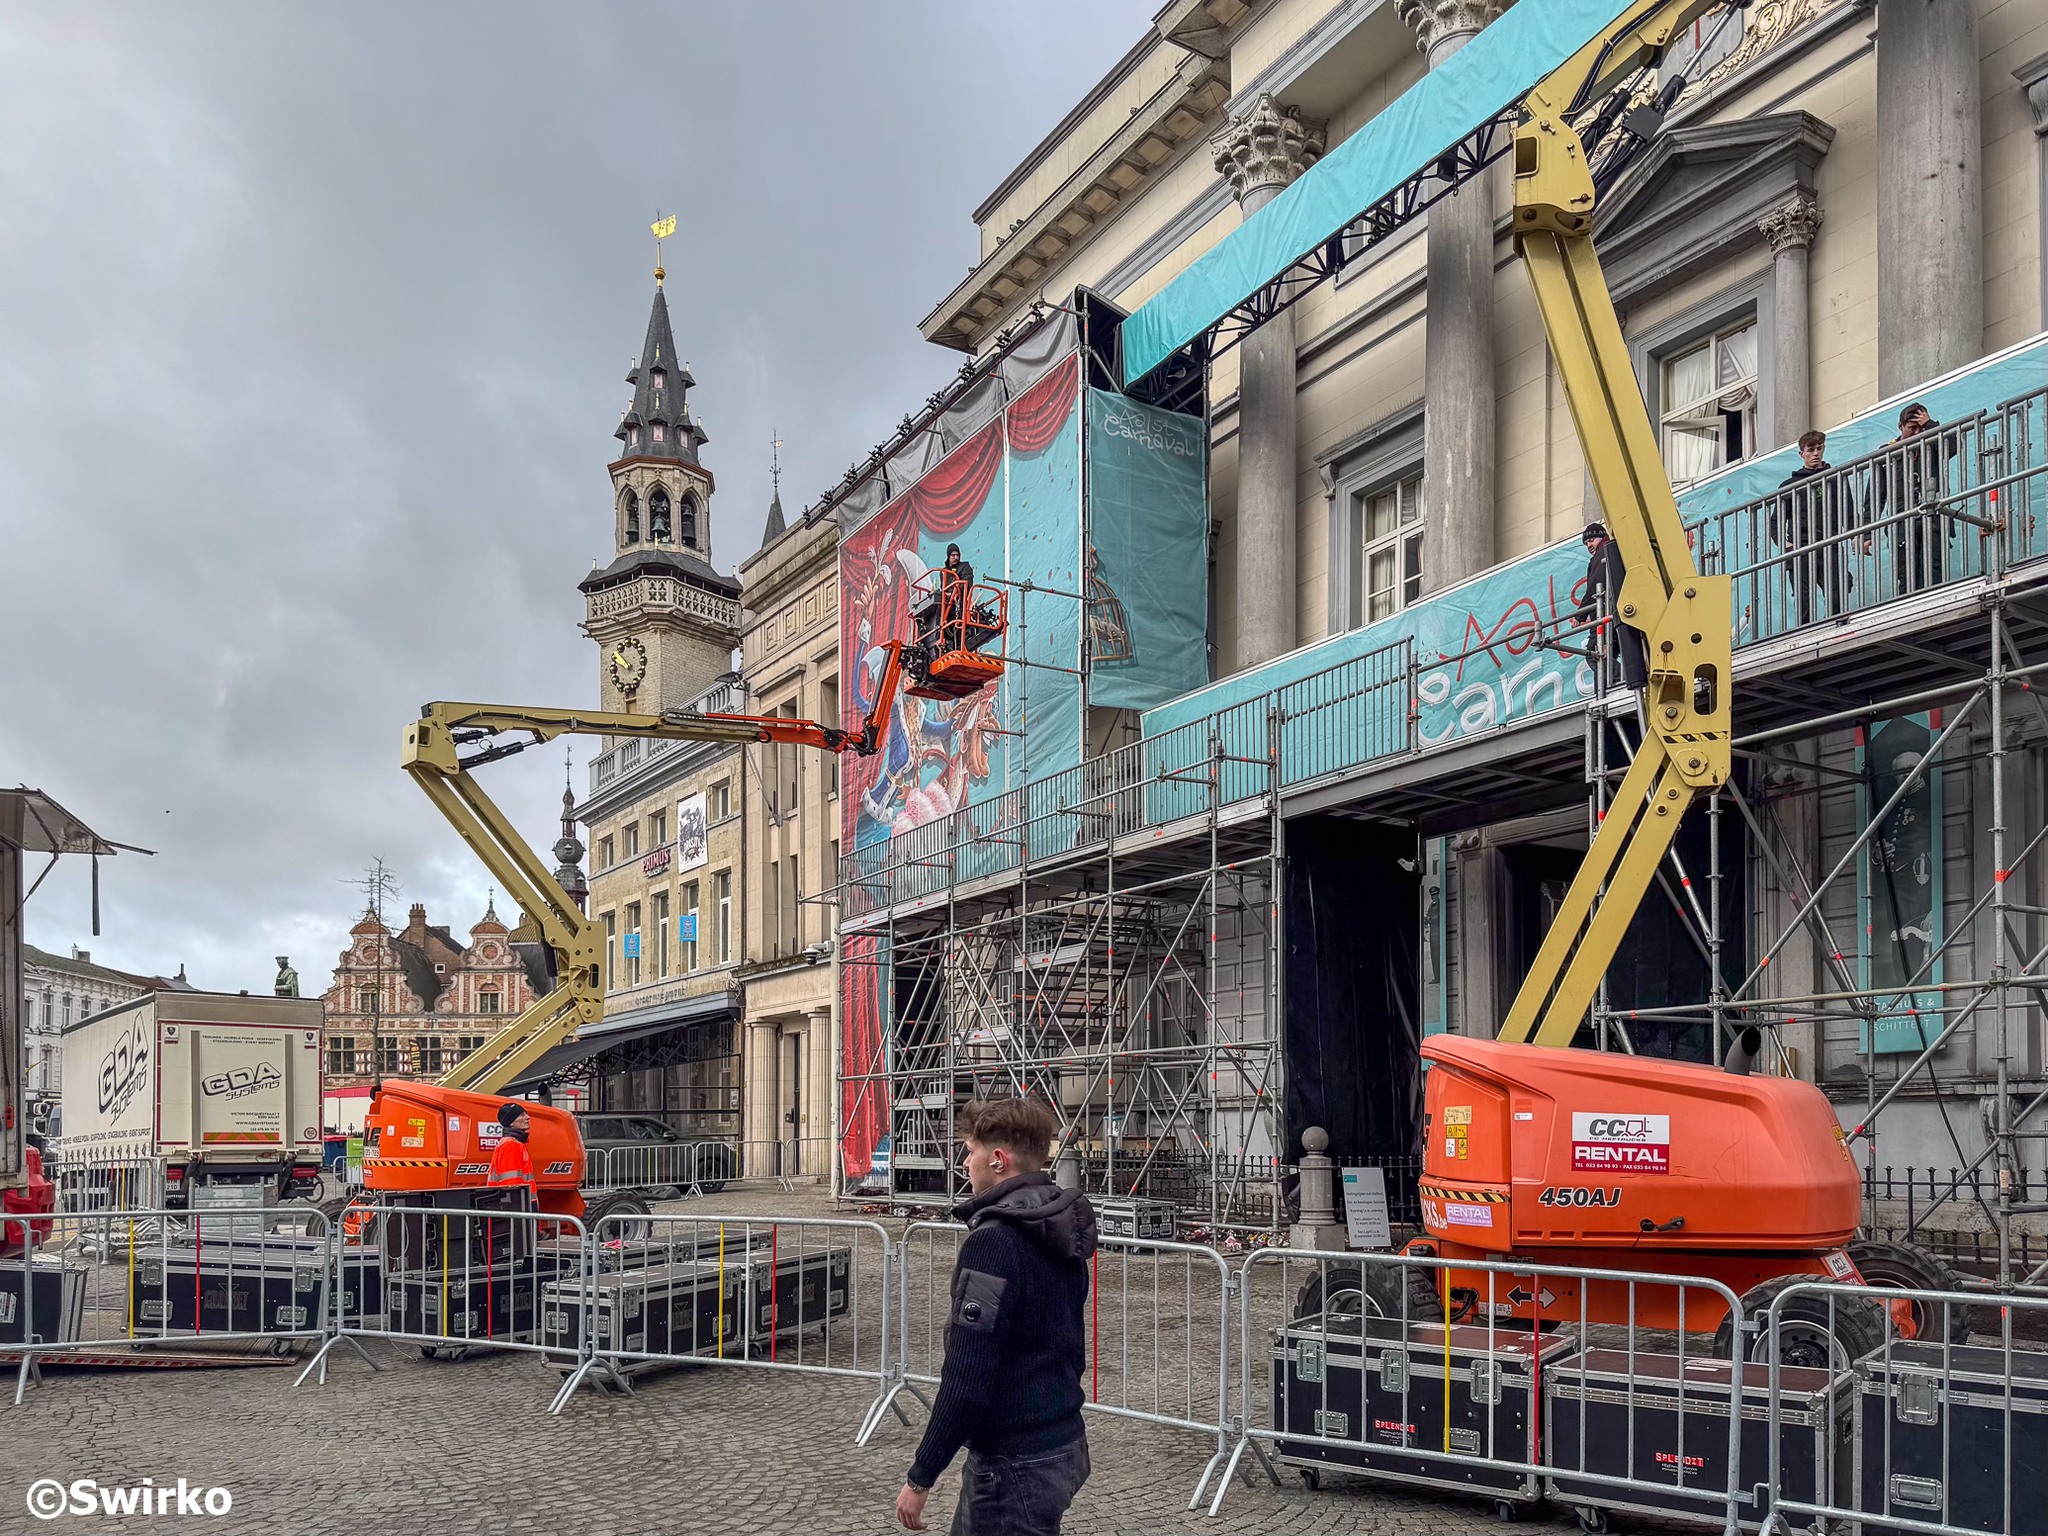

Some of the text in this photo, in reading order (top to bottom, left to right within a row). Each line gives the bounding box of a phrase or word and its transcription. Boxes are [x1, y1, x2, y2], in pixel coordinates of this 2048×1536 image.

[1113, 408, 1183, 437] Aalst
[1104, 415, 1194, 456] Carnaval
[643, 848, 671, 873] PRIMUS
[1926, 998, 1935, 1006] &
[98, 1010, 149, 1115] GDA
[202, 1061, 282, 1096] GDA
[225, 1079, 280, 1101] systems
[1589, 1119, 1626, 1137] CC
[1575, 1146, 1667, 1163] RENTAL
[543, 1162, 574, 1175] JLG
[1539, 1187, 1622, 1208] 450AJ
[1447, 1206, 1490, 1219] RENTAL
[1655, 1452, 1704, 1467] SPLEDIT
